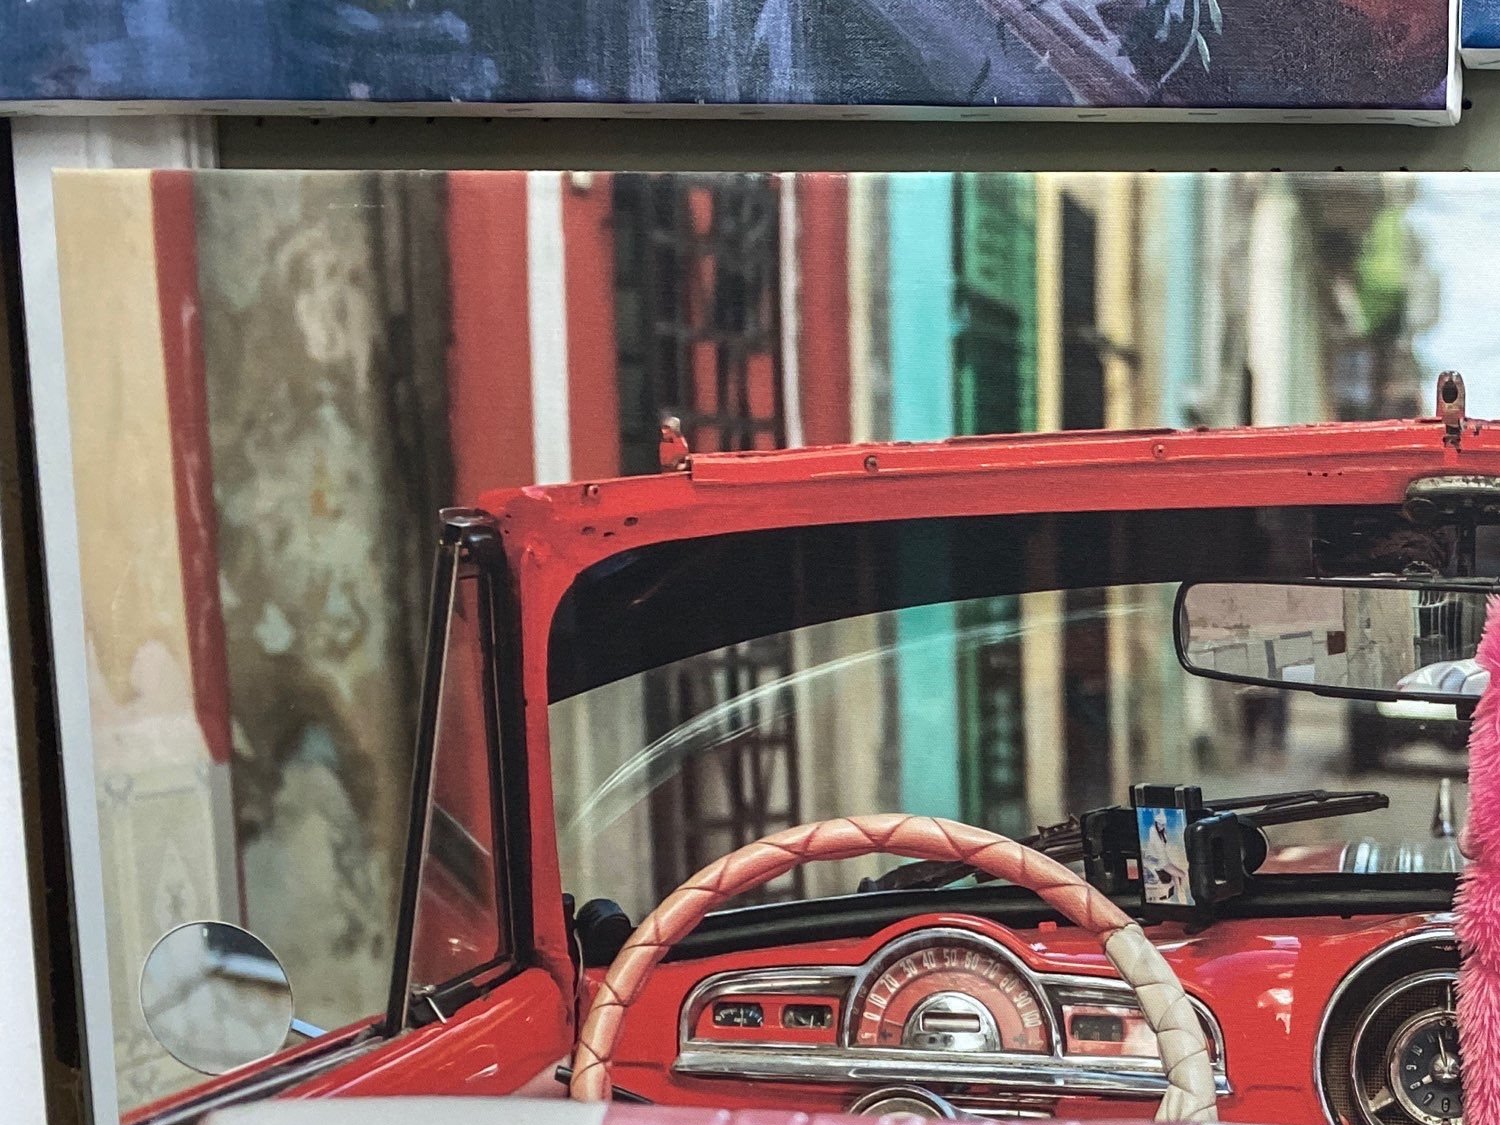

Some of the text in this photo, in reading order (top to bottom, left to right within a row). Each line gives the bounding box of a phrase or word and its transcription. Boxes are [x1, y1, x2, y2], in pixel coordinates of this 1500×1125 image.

[868, 992, 888, 1009] 10
[881, 973, 900, 994] 20
[901, 958, 918, 978] 30
[922, 951, 937, 968] 40
[943, 949, 957, 967] 50
[964, 951, 979, 970] 60
[982, 959, 1000, 980] 70
[1014, 990, 1033, 1008] 90
